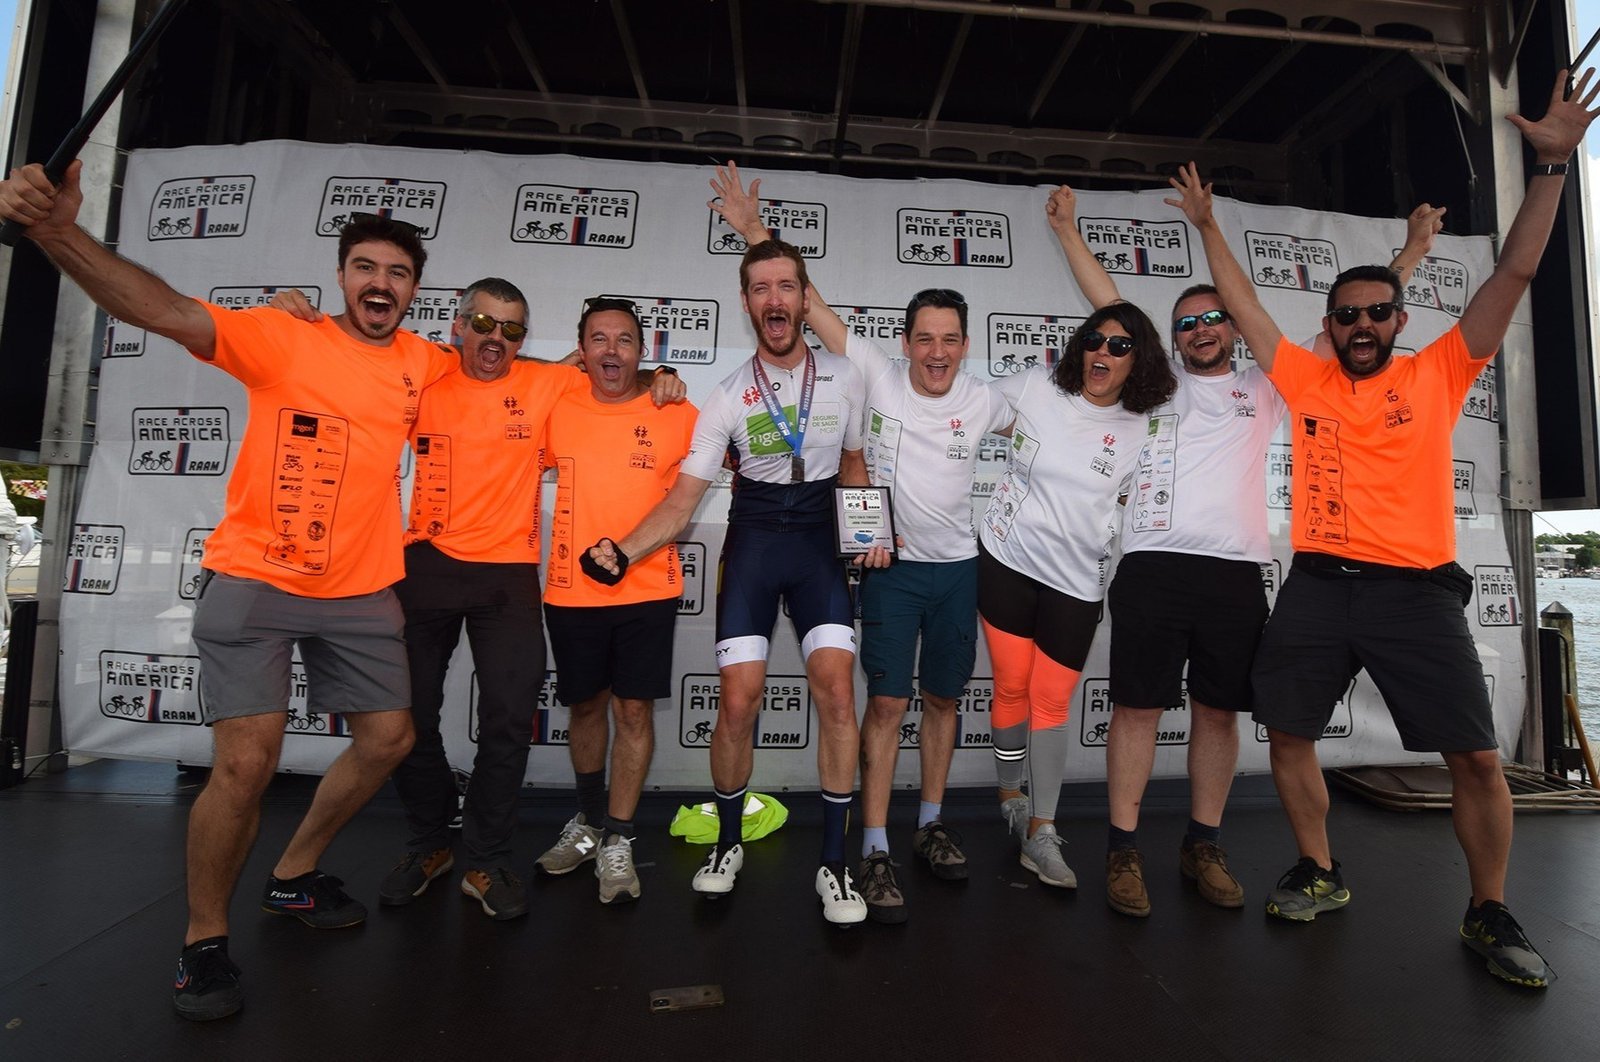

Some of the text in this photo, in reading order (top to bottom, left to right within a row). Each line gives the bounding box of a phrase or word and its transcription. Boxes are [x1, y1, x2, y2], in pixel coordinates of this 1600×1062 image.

[163, 183, 246, 197] RACE ACROSS
[333, 185, 436, 197] RACE ACROSS
[158, 193, 244, 209] AMERICA
[330, 194, 435, 209] AMERICA
[525, 191, 629, 206] RACE ACROSS
[523, 200, 628, 218] AMERICA
[762, 207, 819, 218] ACROSS
[905, 215, 1002, 228] RACE ACROSS
[207, 223, 239, 234] RAAM
[905, 224, 1002, 239] AMERICA
[1087, 224, 1179, 237] RACE ACROSS
[588, 233, 626, 245] RAAM
[1087, 232, 1181, 249] AMERICA
[1253, 238, 1331, 256] RACE ACROSS
[970, 254, 1005, 264] RAAM
[1255, 246, 1333, 268] AMERICA
[1152, 264, 1185, 274] RAAM
[1412, 267, 1463, 289] MERICA
[216, 296, 251, 304] RACE
[413, 297, 442, 306] ACE
[650, 306, 710, 317] ACROSS
[641, 315, 709, 331] ERICA
[847, 315, 905, 326] ACROSS
[996, 323, 1076, 334] RACE ACRO
[996, 332, 1065, 347] AMERI
[114, 342, 139, 353] RAAM
[670, 349, 708, 360] RAAM
[138, 418, 222, 426] RACE ACROSS
[139, 428, 223, 441] AMERICA
[1102, 447, 1115, 456] IPO
[188, 461, 220, 471] RAAM
[74, 534, 119, 545] ACROSS
[81, 578, 111, 590] RAAM
[1480, 574, 1502, 582] RACE
[1481, 583, 1514, 595] AMER
[106, 660, 195, 675] RACE ACROSS
[106, 671, 193, 691] AMERICA
[691, 685, 720, 694] RAC
[162, 710, 196, 721] RAAM
[1324, 725, 1347, 734] AAM
[761, 733, 800, 744] RAAM
